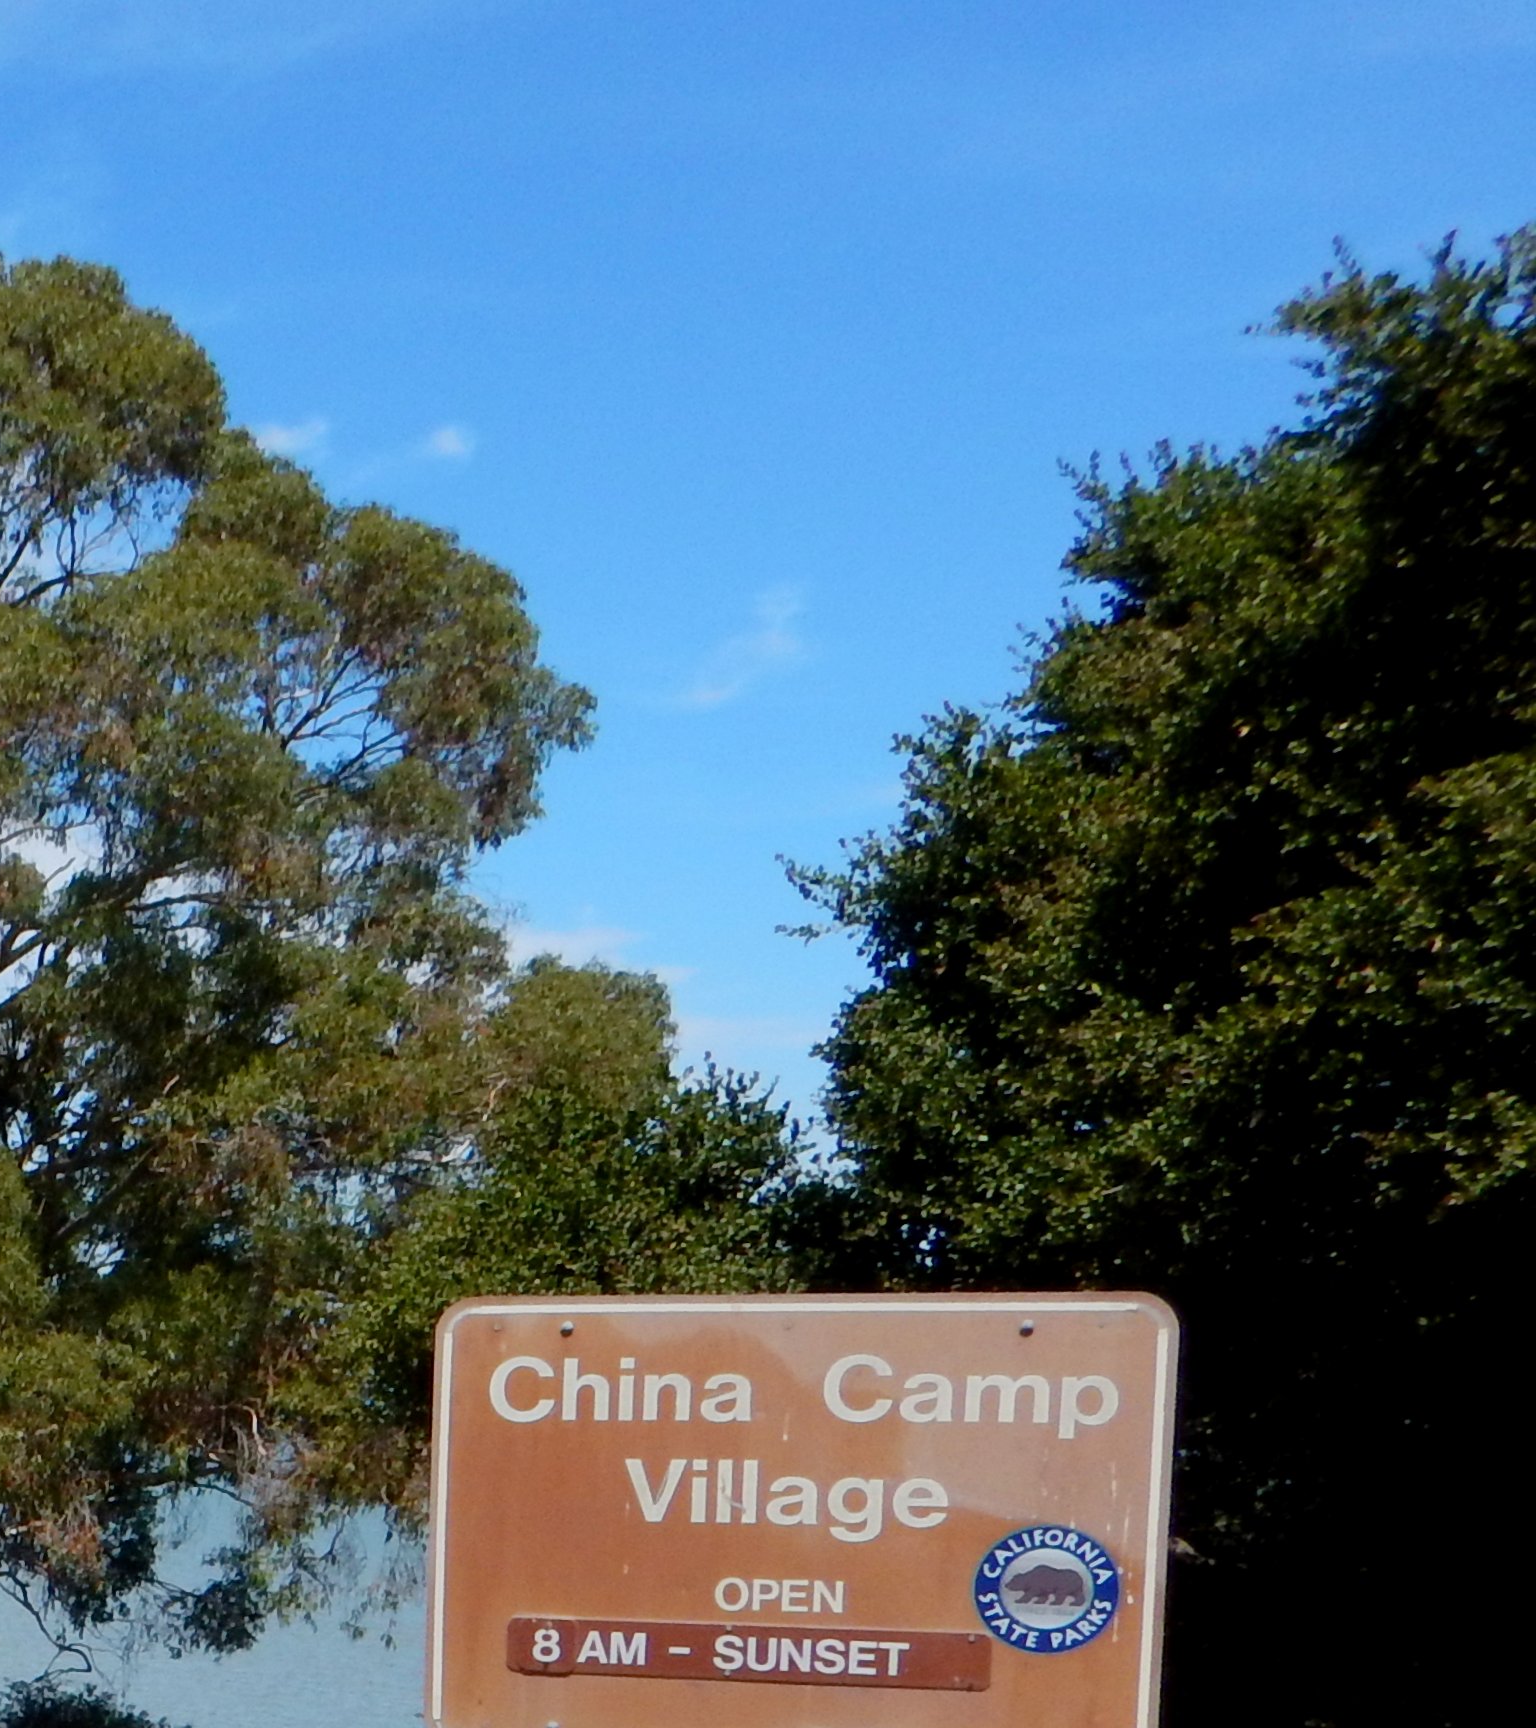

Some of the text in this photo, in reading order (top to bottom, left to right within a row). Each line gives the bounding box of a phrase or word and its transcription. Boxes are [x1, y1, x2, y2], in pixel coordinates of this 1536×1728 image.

[489, 1353, 1120, 1440] China Camp
[625, 1458, 949, 1543] Village
[982, 1528, 1114, 1585] CALIFORNIA
[714, 1577, 845, 1614] OPEN
[978, 1591, 1113, 1649] STATE PARKS
[532, 1627, 561, 1663] 8
[577, 1630, 647, 1667] AM
[712, 1635, 911, 1677] SUNSET
